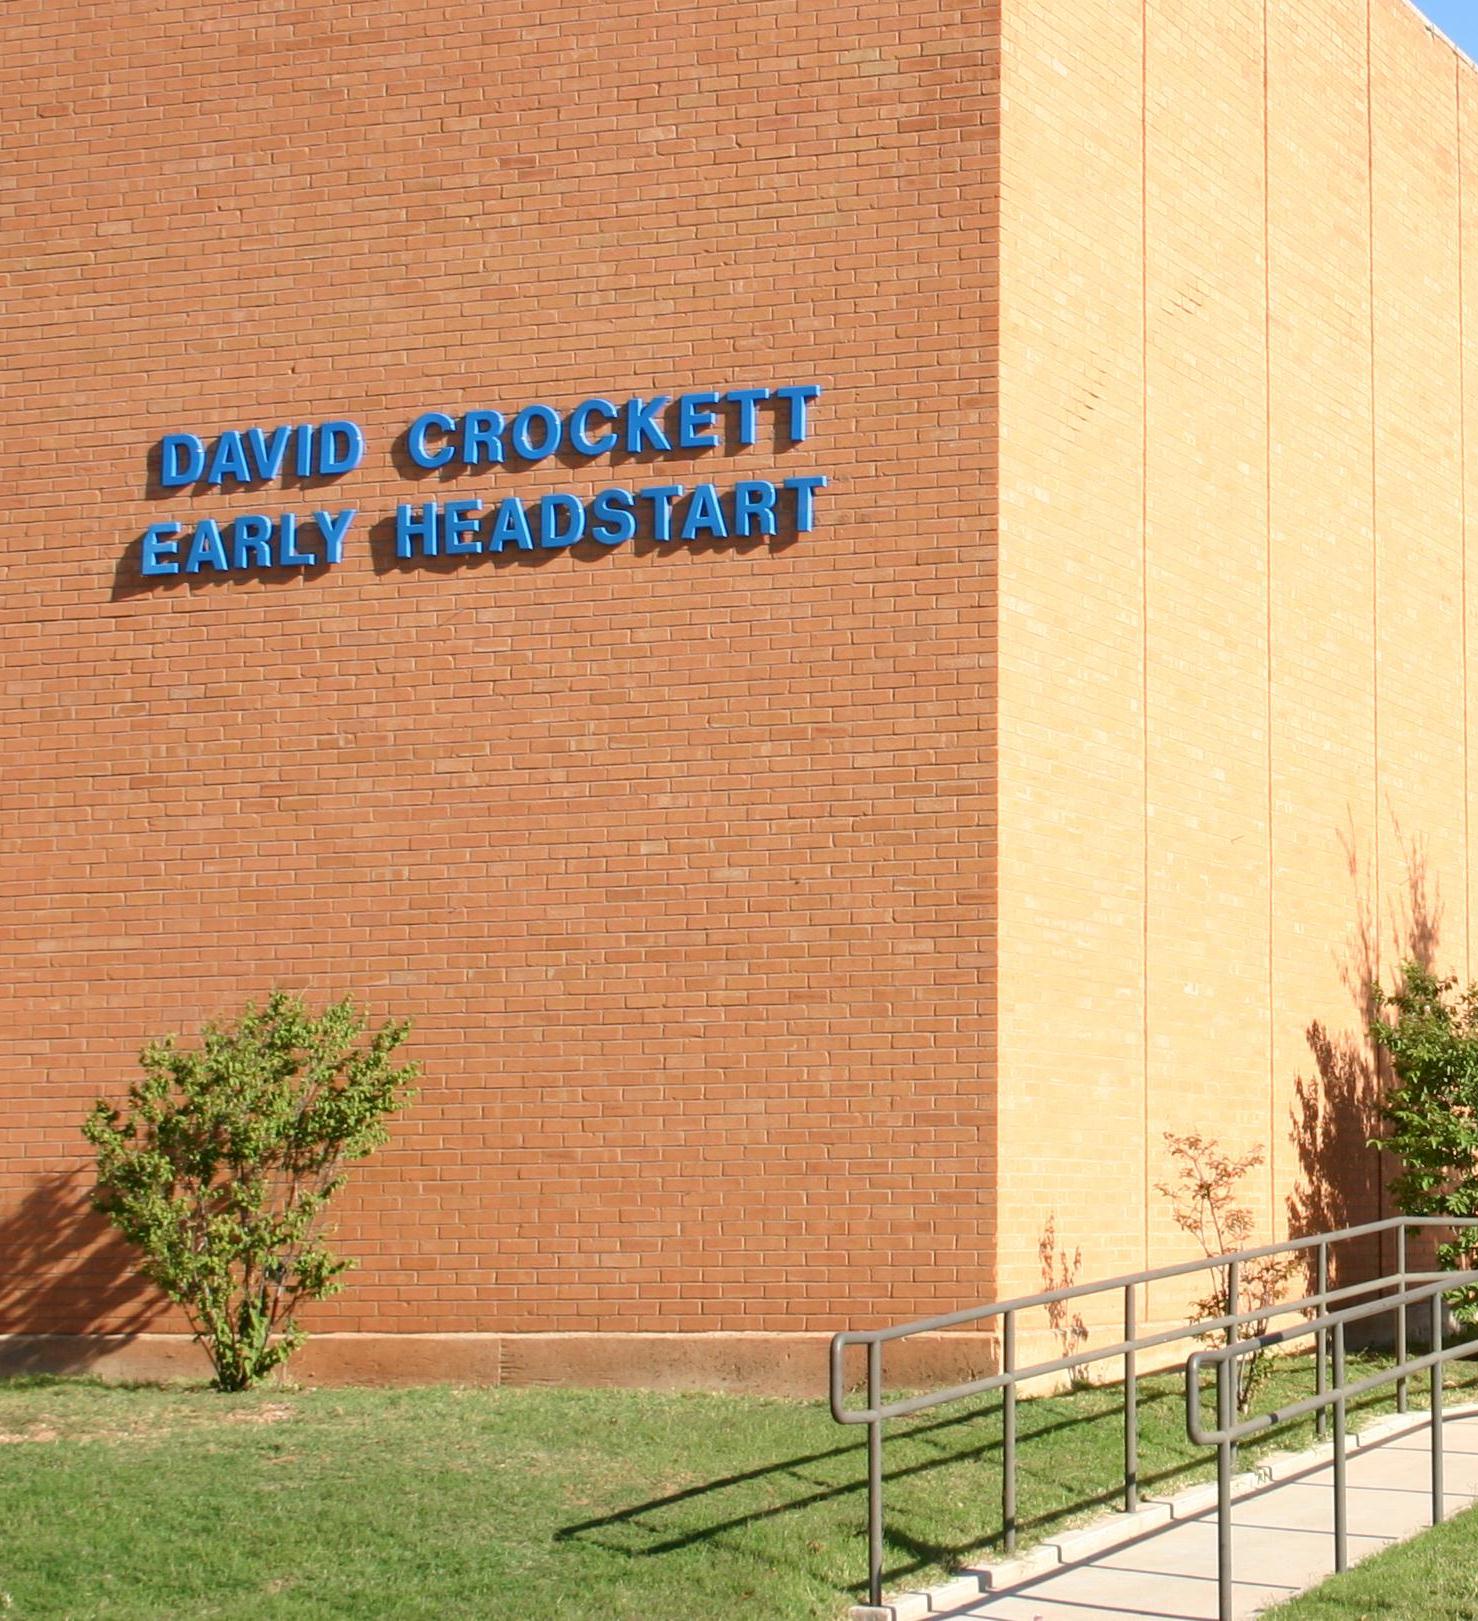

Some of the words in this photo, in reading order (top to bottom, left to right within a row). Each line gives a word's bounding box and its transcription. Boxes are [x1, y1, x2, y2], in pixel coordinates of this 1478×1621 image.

[161, 420, 366, 488] DAVID
[408, 384, 822, 470] CROCKETT
[140, 509, 357, 577] EARLY
[396, 475, 829, 558] HEADSTART
